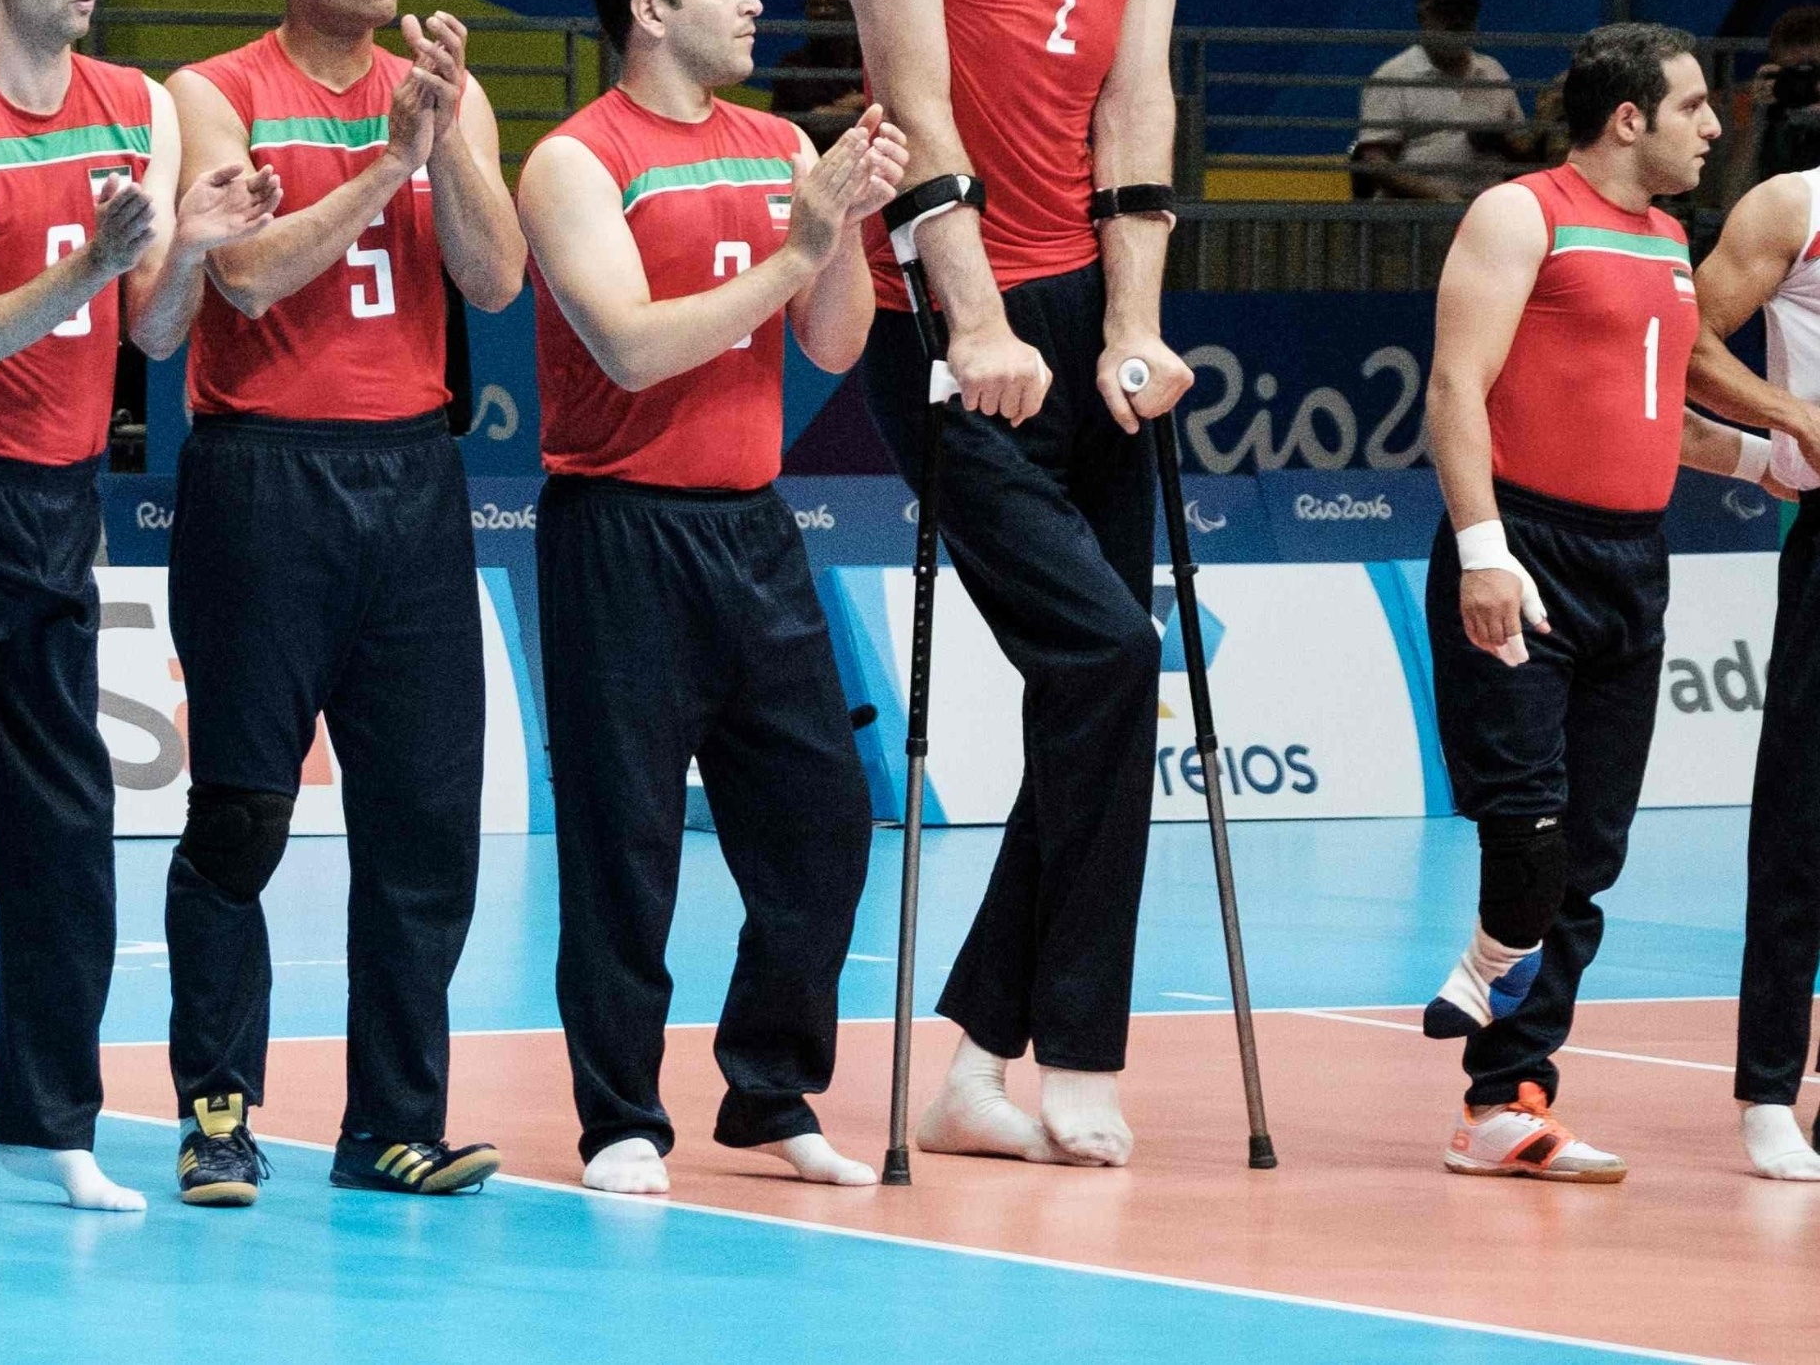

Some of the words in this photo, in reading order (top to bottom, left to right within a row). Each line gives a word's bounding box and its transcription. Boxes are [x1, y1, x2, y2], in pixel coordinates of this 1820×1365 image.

[346, 210, 397, 319] 5
[1643, 315, 1661, 421] 1
[1294, 493, 1393, 520] Rio2016
